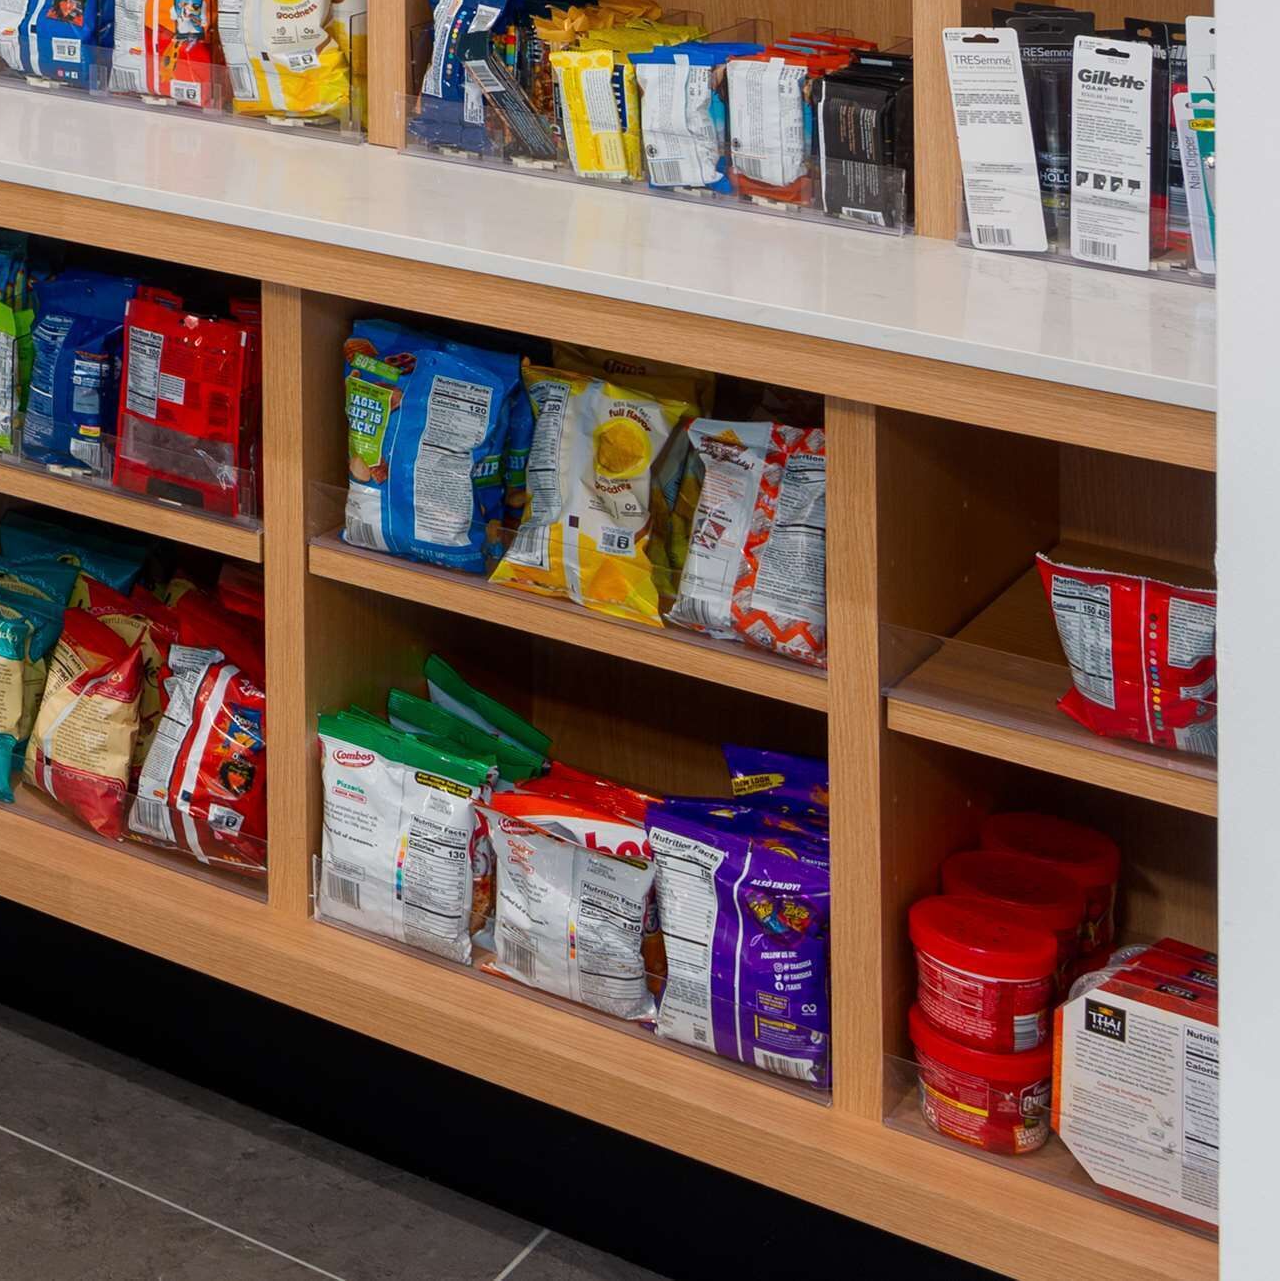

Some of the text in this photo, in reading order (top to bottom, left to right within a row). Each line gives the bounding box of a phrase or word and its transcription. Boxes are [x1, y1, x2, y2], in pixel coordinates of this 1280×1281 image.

[275, 2, 319, 20] goodness
[952, 53, 1012, 66] TRESemmé
[1077, 68, 1146, 92] Gillette
[1081, 84, 1109, 93] FOAMY
[1185, 135, 1201, 191] Nail Clipper
[436, 377, 491, 395] Nutrition Facts
[431, 398, 488, 416] Calories 120
[369, 412, 383, 424] IS
[608, 407, 653, 434] full flavor
[1082, 604, 1097, 616] 150
[335, 748, 373, 762] Combos
[413, 816, 468, 839] Nutrition Facts
[408, 838, 466, 860] Calories 130
[652, 831, 721, 863] Nutrition Facts
[750, 878, 802, 892] ALSO ENJOY!
[582, 882, 643, 911] Nutrition Facts
[621, 921, 641, 933] 130
[1088, 1010, 1122, 1032] THAI
[1186, 1028, 1219, 1046] Nutriti
[1185, 1060, 1219, 1076] Calorie
